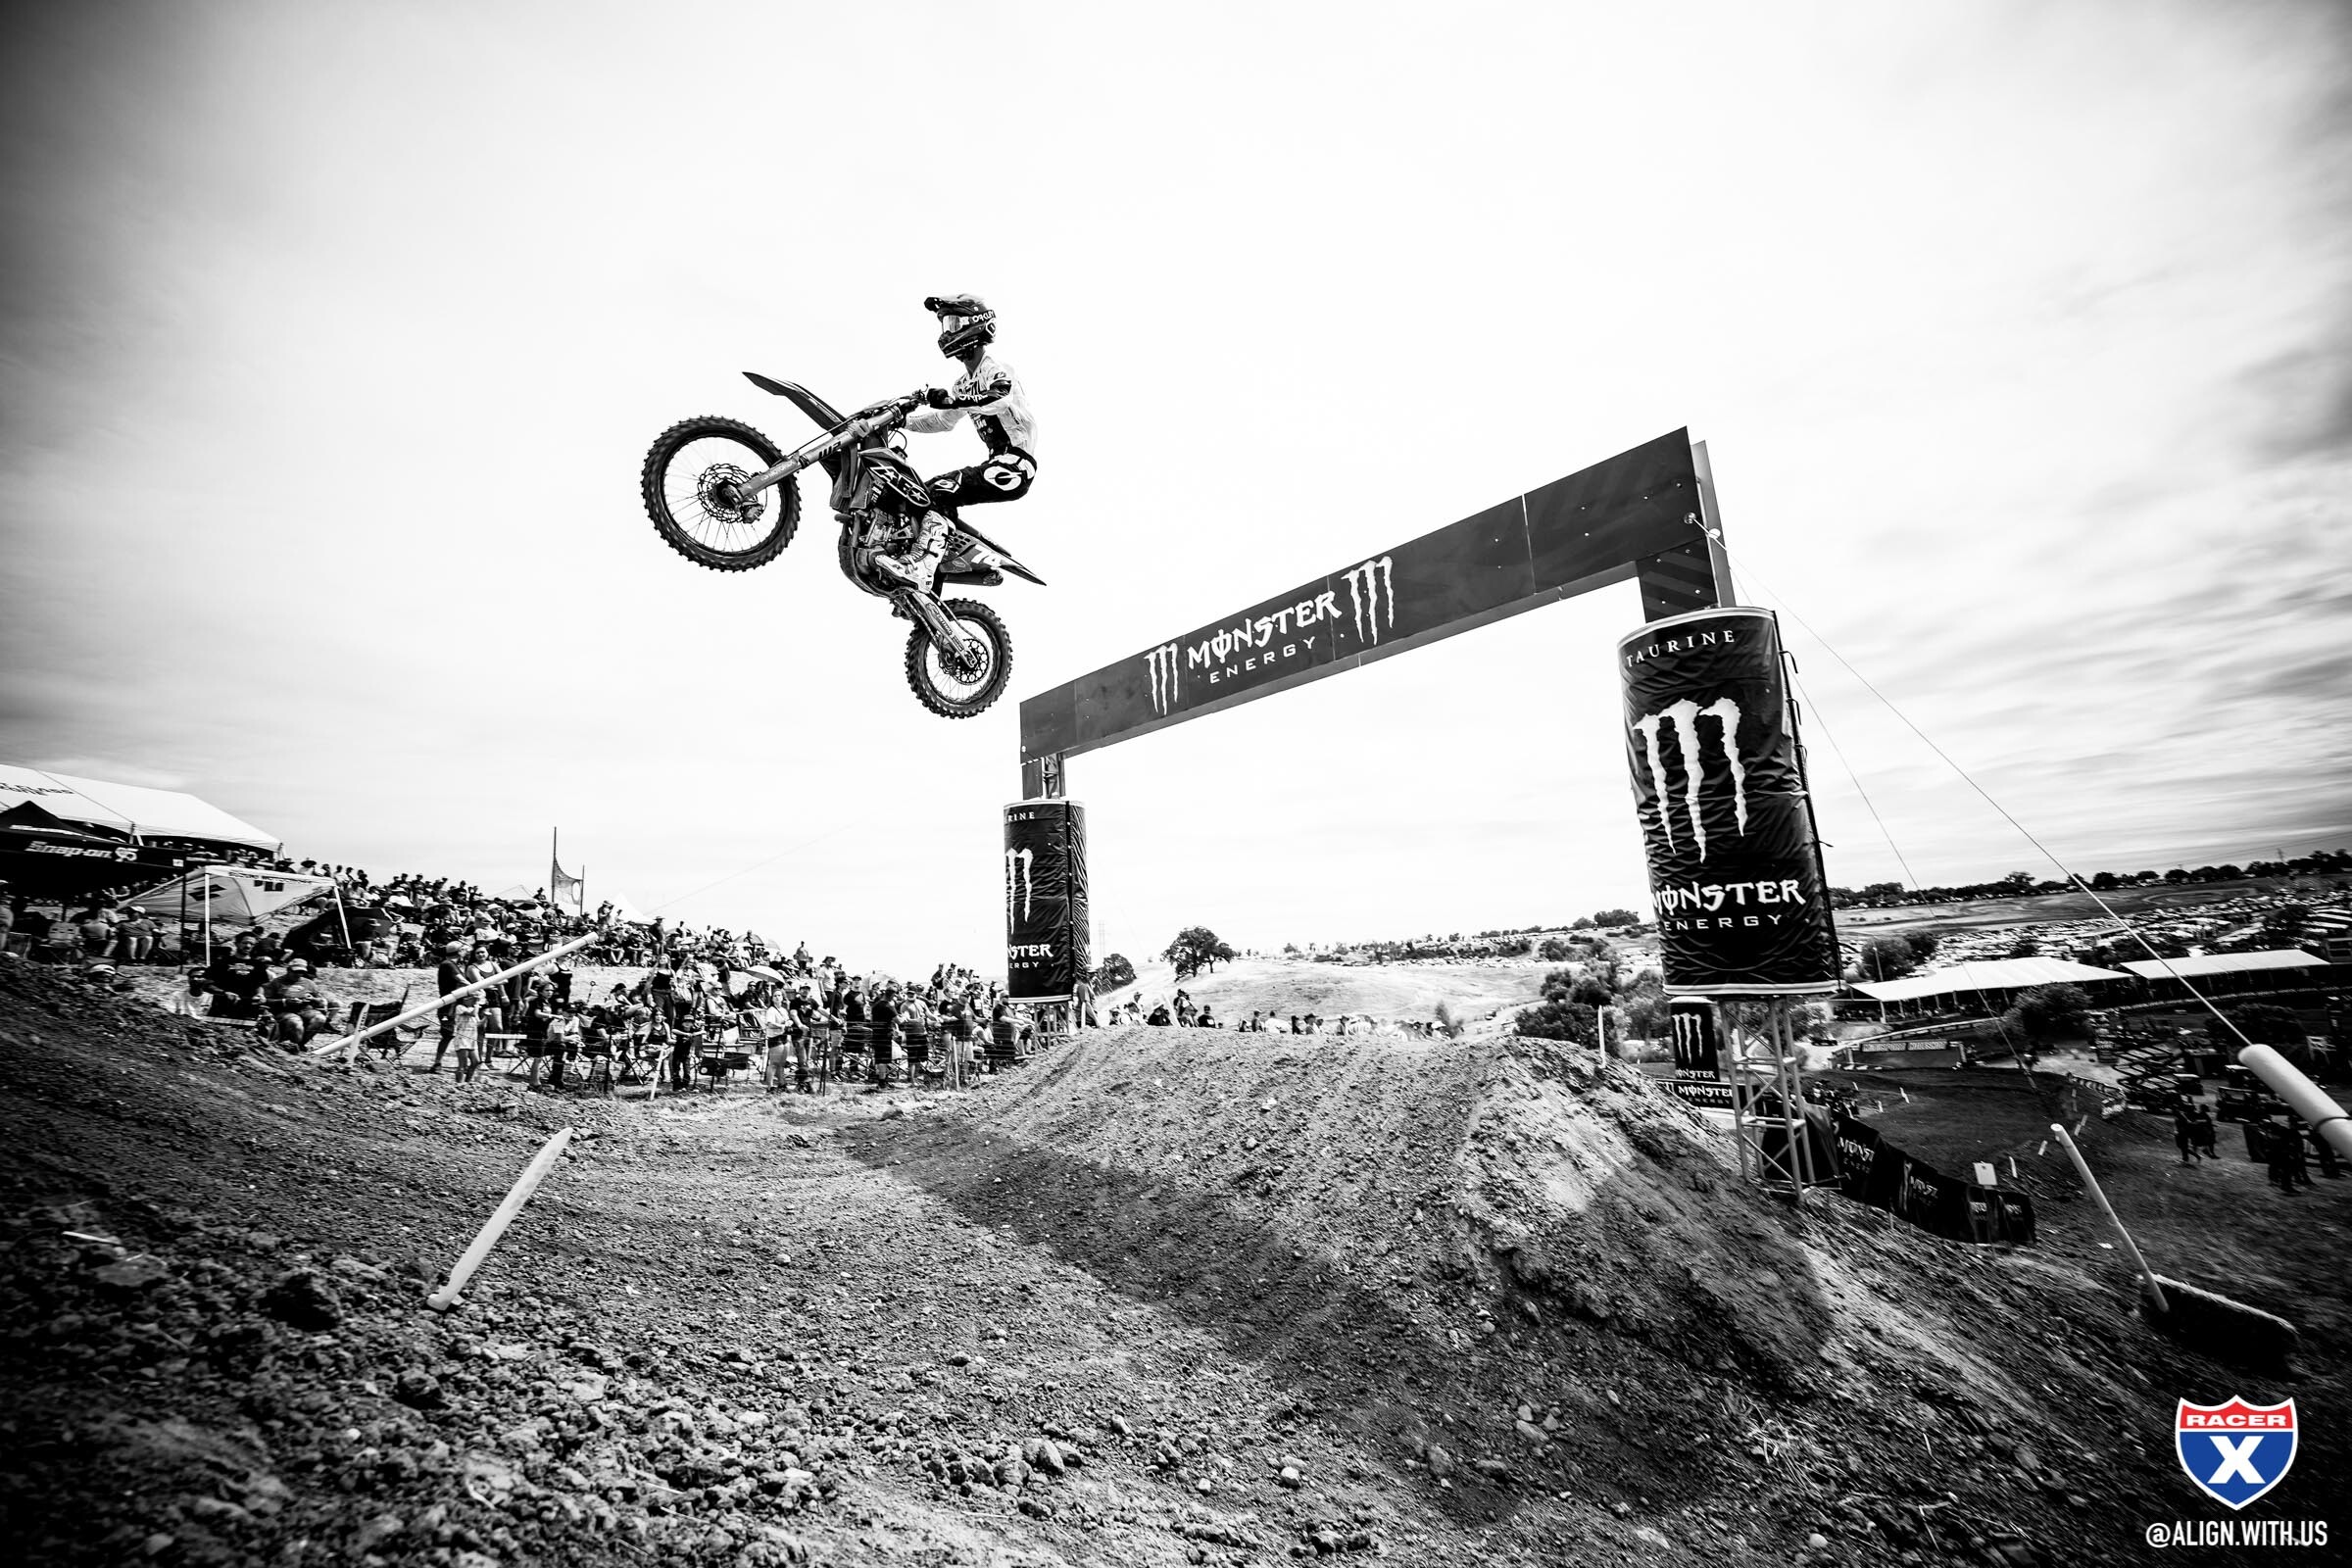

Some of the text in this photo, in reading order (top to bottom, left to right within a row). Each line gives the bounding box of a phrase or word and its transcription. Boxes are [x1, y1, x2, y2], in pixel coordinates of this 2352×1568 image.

[971, 310, 995, 323] OAKLEY
[1187, 590, 1343, 670] MONSTER
[1209, 635, 1316, 685] ENERGY
[1626, 629, 1736, 667] TAURINE
[24, 841, 113, 858] Snap-on
[1663, 913, 1783, 931] ENERGY
